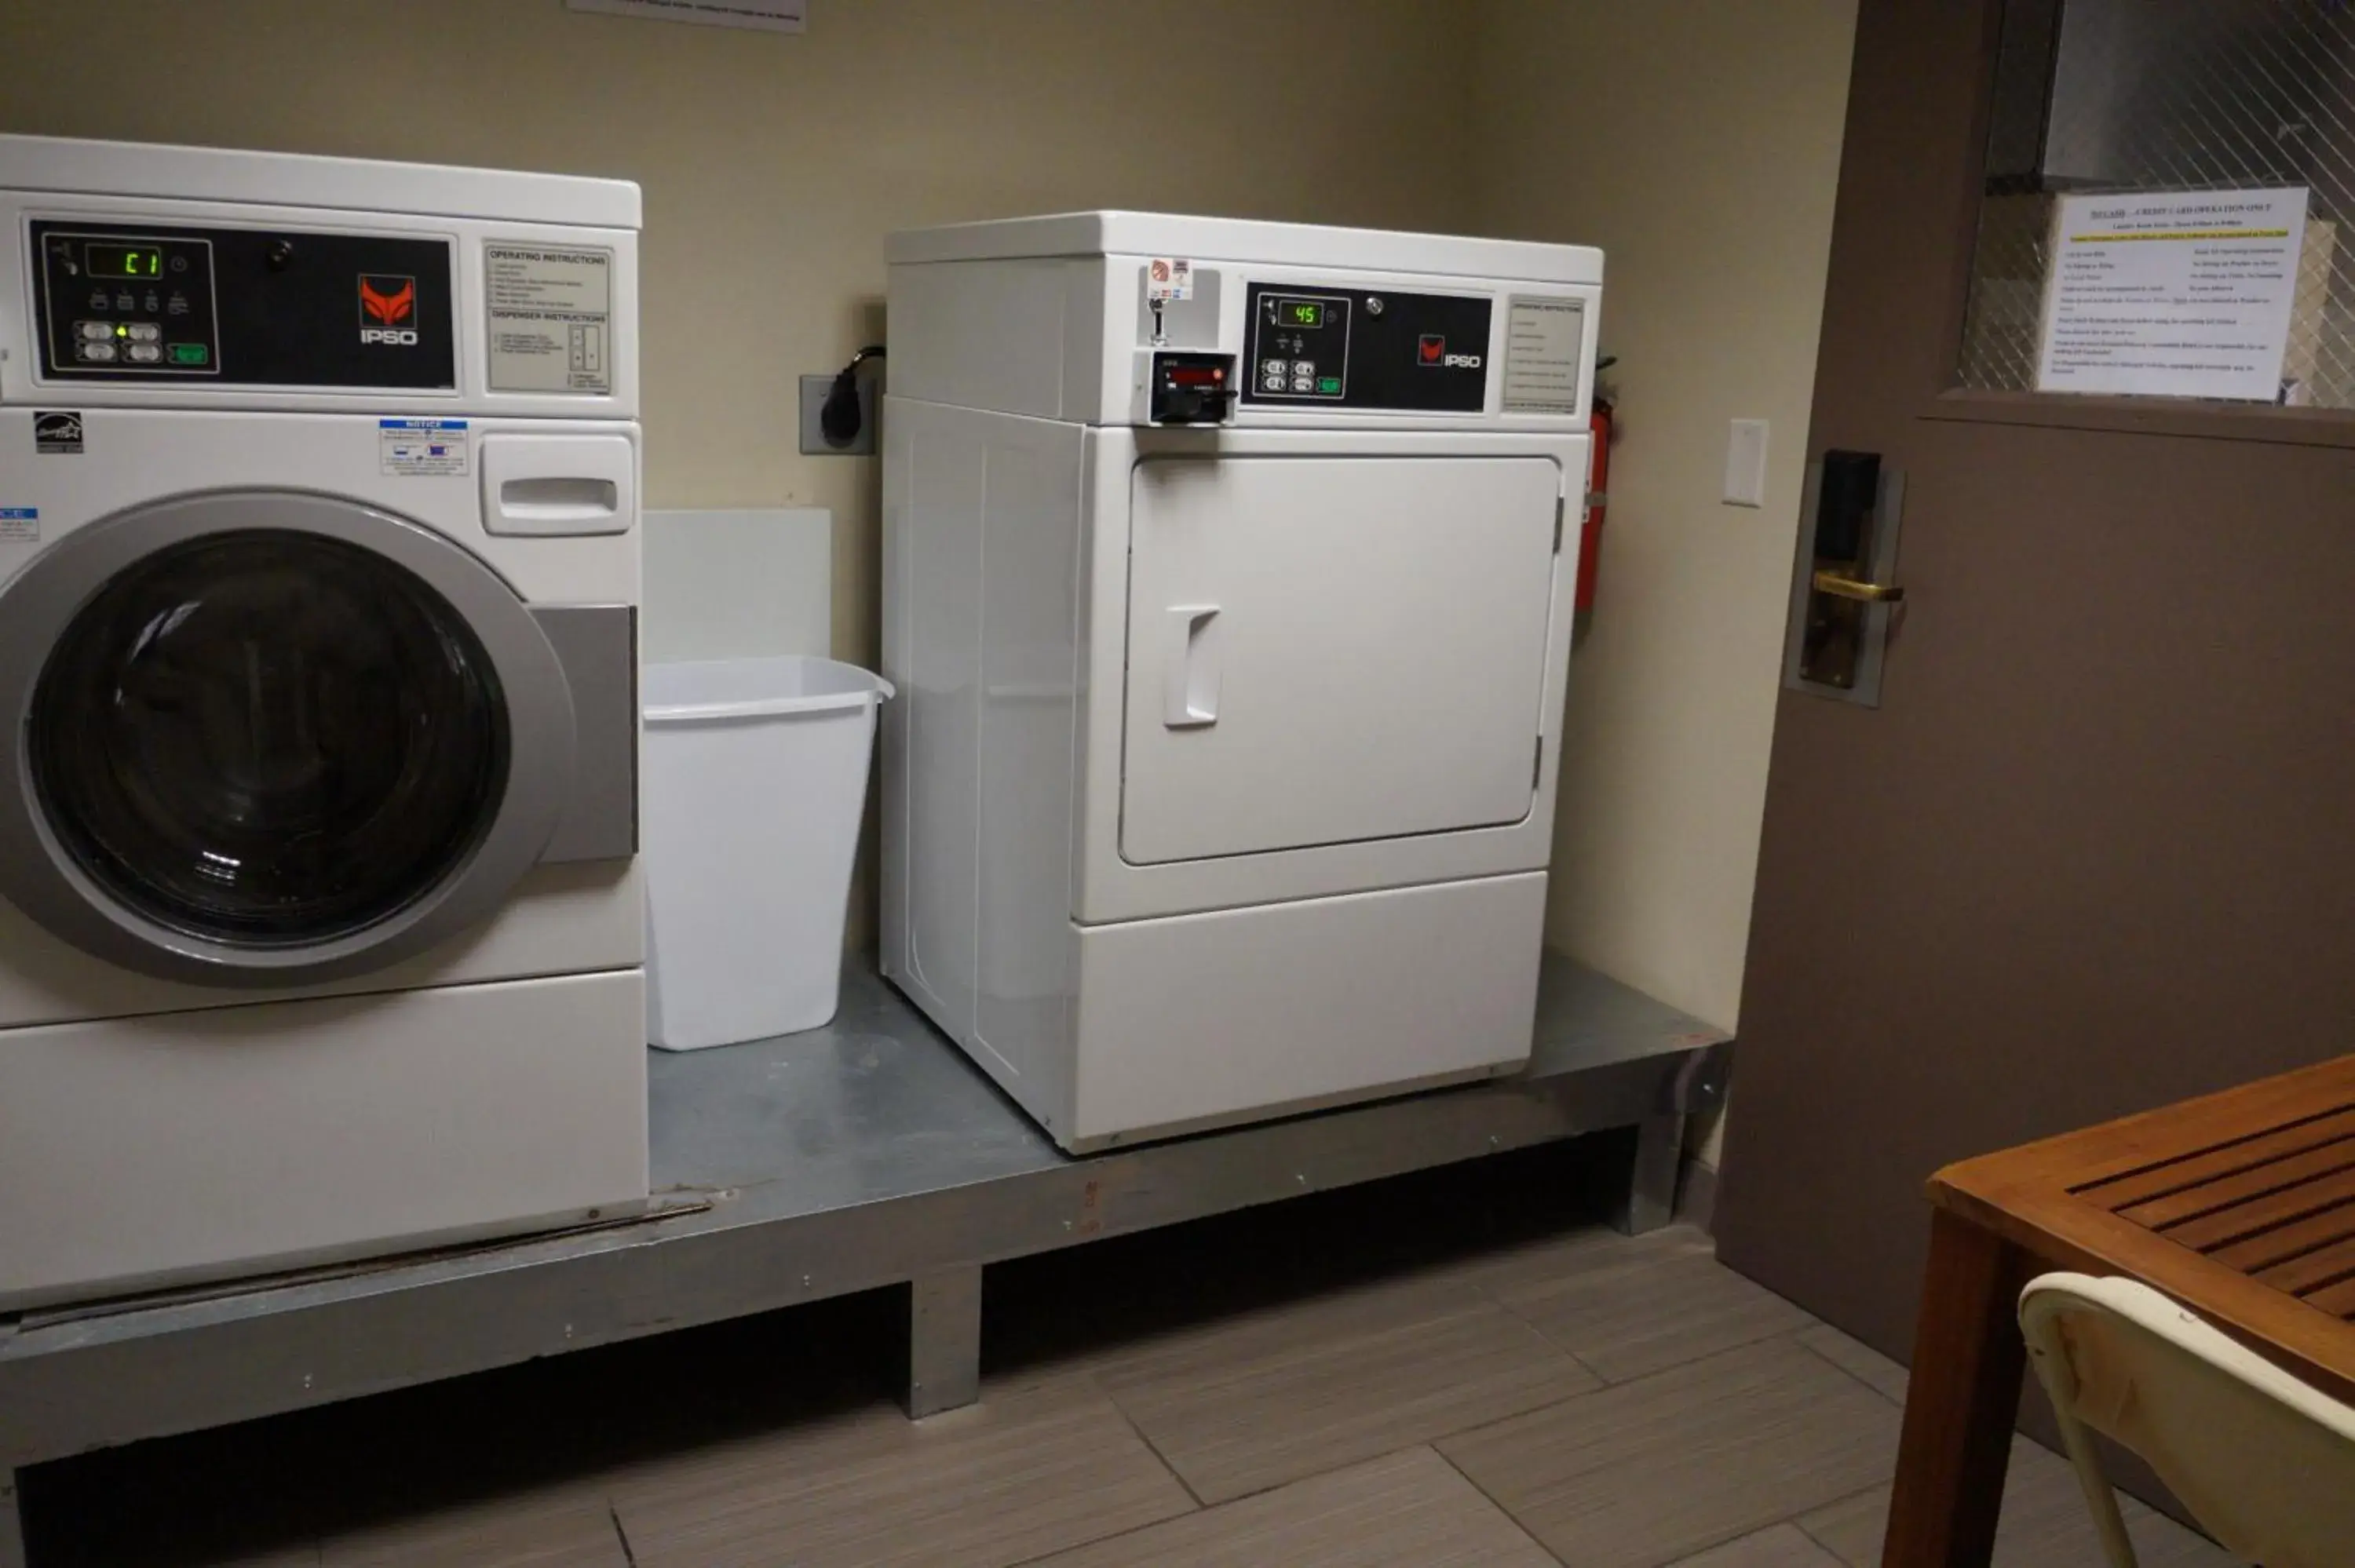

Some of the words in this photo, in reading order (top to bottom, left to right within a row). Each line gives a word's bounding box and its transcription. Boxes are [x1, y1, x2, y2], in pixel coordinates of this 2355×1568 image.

[543, 254, 606, 265] INSTRUCTIONS
[1296, 306, 1315, 323] 45
[360, 329, 418, 346] IPSO
[1444, 353, 1481, 368] IPSO
